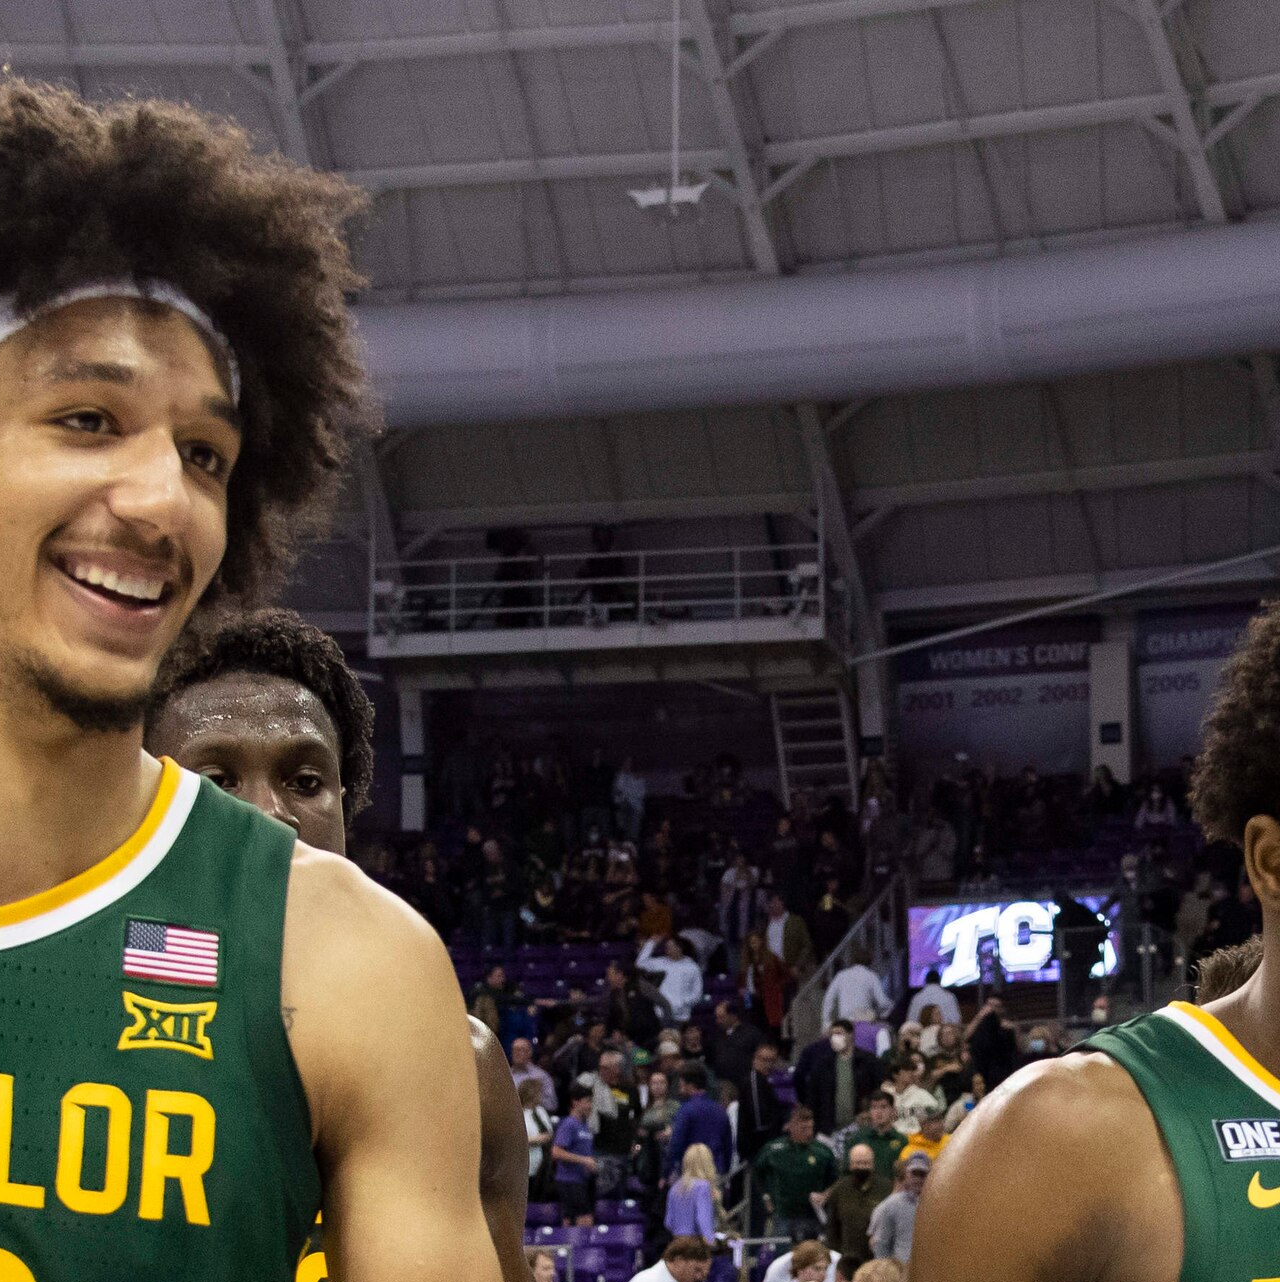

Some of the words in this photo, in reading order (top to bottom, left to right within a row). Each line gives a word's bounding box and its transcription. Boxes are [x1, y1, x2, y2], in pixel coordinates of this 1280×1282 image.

[928, 646, 1028, 671] WOMEN'S
[1033, 641, 1088, 665] CONF
[1147, 673, 1201, 695] 2005
[906, 691, 955, 712] 2001
[970, 687, 1023, 708] 2002
[938, 902, 1117, 987] TC
